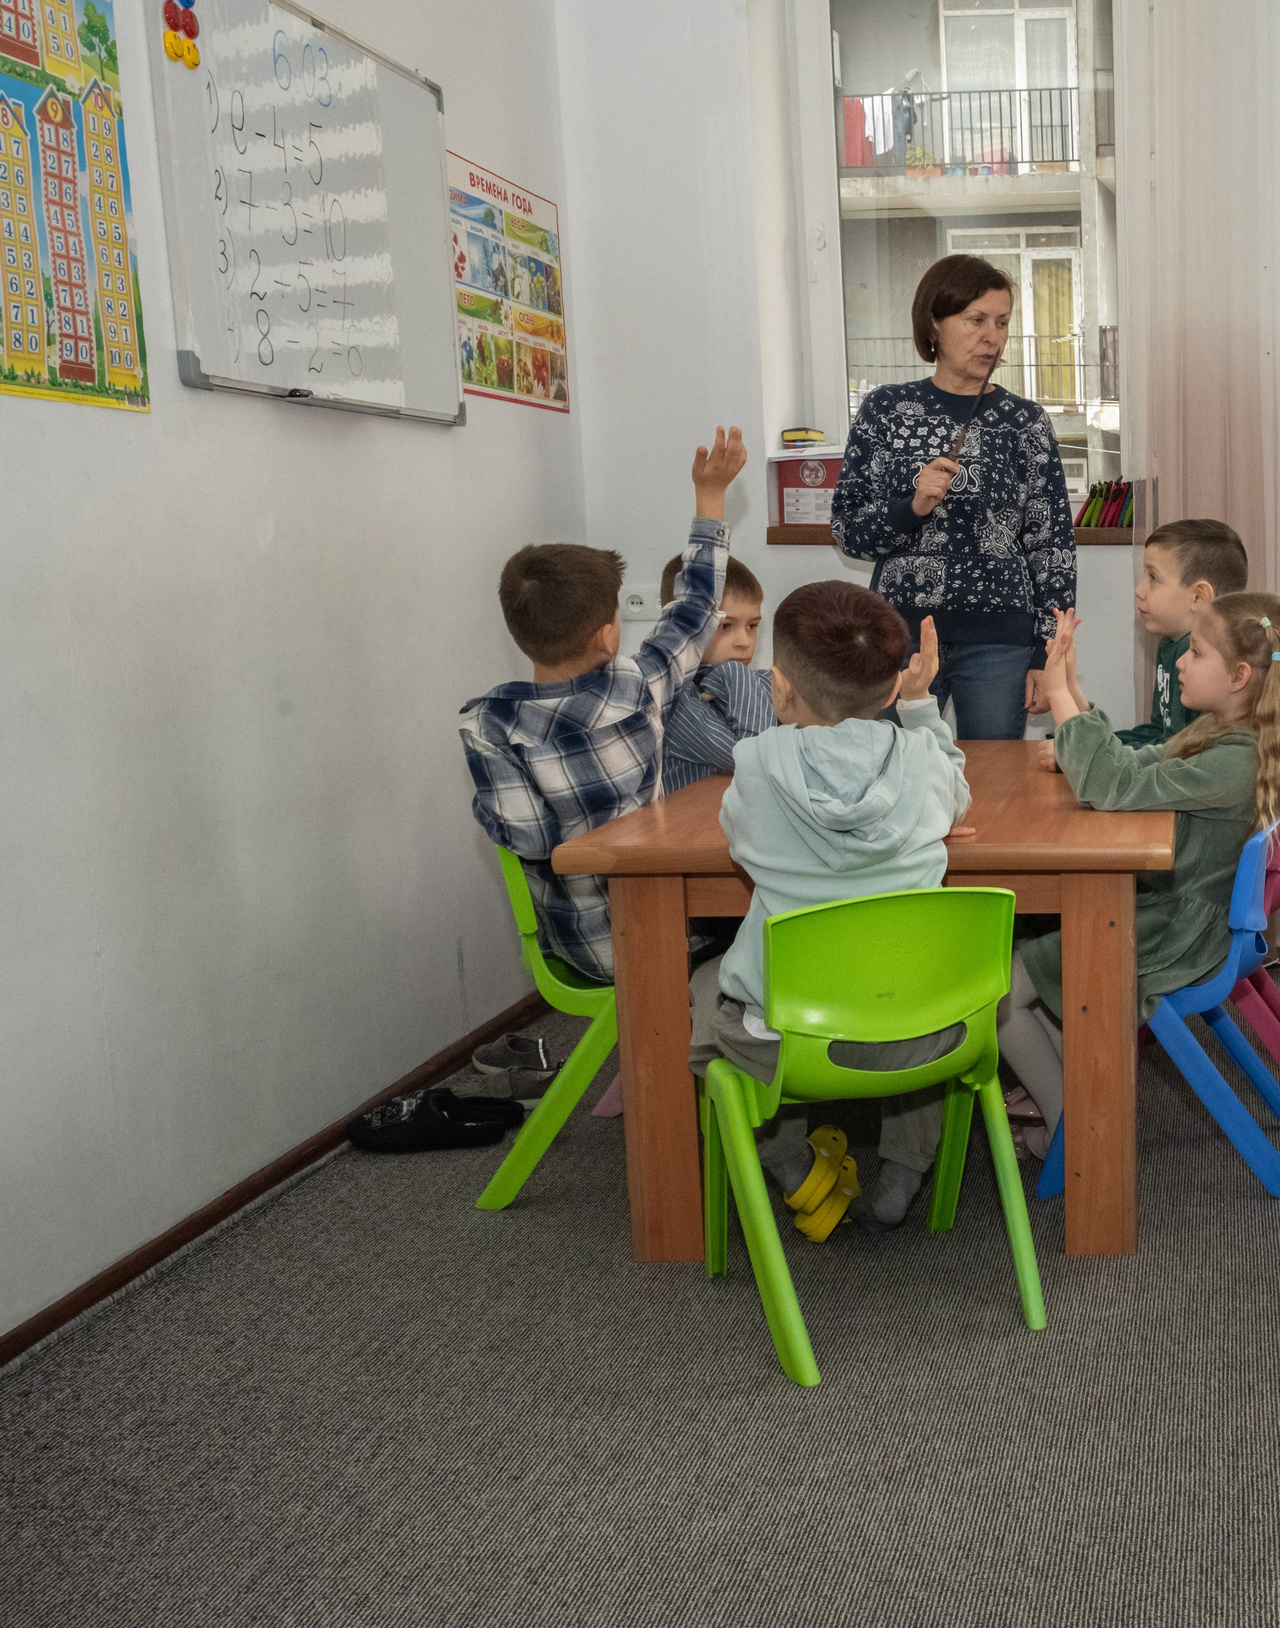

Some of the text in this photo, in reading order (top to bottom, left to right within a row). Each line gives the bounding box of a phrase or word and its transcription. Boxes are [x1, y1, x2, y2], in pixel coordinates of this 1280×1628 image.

[5, 16, 30, 39] 4 0
[48, 10, 68, 31] 4 1
[52, 35, 74, 58] 5 0
[50, 101, 58, 118] 9
[92, 89, 104, 111] 10
[1, 107, 9, 126] 8
[91, 117, 111, 136] 1 9
[47, 128, 69, 148] 1 8
[13, 140, 21, 156] 7
[92, 143, 112, 163] 2 8
[0, 164, 24, 185] 2 6
[49, 154, 70, 176] 2 7
[95, 169, 115, 189] 3 7
[50, 181, 72, 202] 3 6
[450, 189, 467, 205] ЗИМА
[469, 172, 533, 216] ВРЕМЕНА ГОДА
[2, 192, 26, 213] 3 5
[96, 196, 118, 215] 4 6
[52, 210, 74, 228] 4 5
[511, 217, 529, 231] ВЕСНА
[5, 222, 29, 241] 4 4
[99, 222, 121, 241] 5 5
[56, 236, 78, 255] 5 4
[8, 248, 32, 268] 5 3
[101, 248, 122, 266] 6 4
[58, 262, 80, 280] 6 3
[10, 276, 34, 296] 6 2
[104, 273, 125, 292] 7 3
[61, 289, 83, 307] 7 2
[459, 292, 475, 306] ЛЕТО
[12, 305, 36, 324] 7 1
[106, 300, 127, 317] 8 2
[63, 315, 85, 334] 8 1
[519, 312, 534, 325] ОСЕНЬ
[14, 332, 38, 351] 8 0
[109, 324, 129, 342] 9 1
[65, 342, 87, 360] 9 0
[110, 350, 132, 367] 10 0
